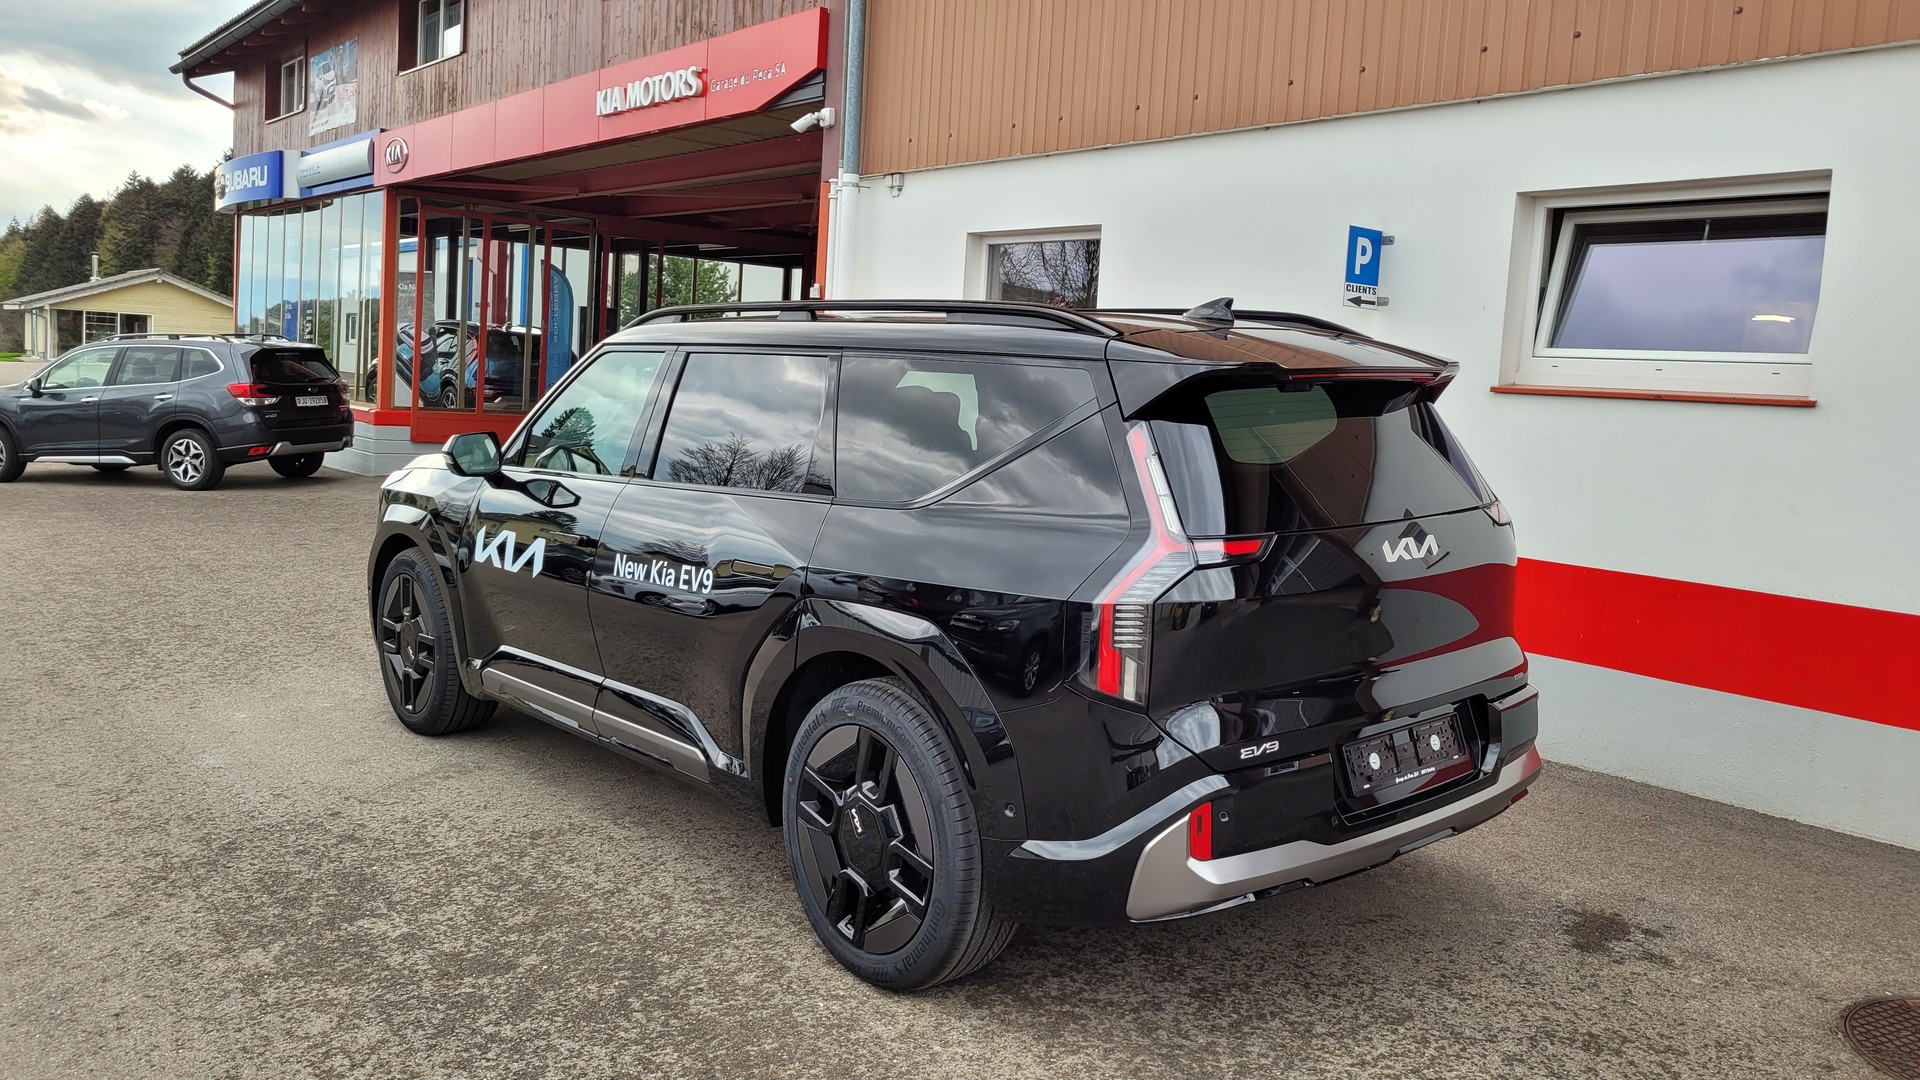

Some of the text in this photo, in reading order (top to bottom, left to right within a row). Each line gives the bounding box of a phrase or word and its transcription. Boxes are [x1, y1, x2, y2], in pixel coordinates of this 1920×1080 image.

[597, 66, 701, 116] KIA MOTORS
[711, 77, 738, 92] Garage
[740, 72, 750, 85] du
[775, 62, 786, 78] SA
[386, 145, 403, 165] KIA
[225, 165, 268, 192] SUBARU
[1354, 236, 1373, 275] P
[1346, 284, 1377, 295] CLIENTS
[475, 525, 546, 579] KIA
[1382, 534, 1439, 563] KIA
[614, 553, 713, 594] New Kia EV9
[857, 700, 926, 770] PremiumContact
[1240, 740, 1280, 760] EV9
